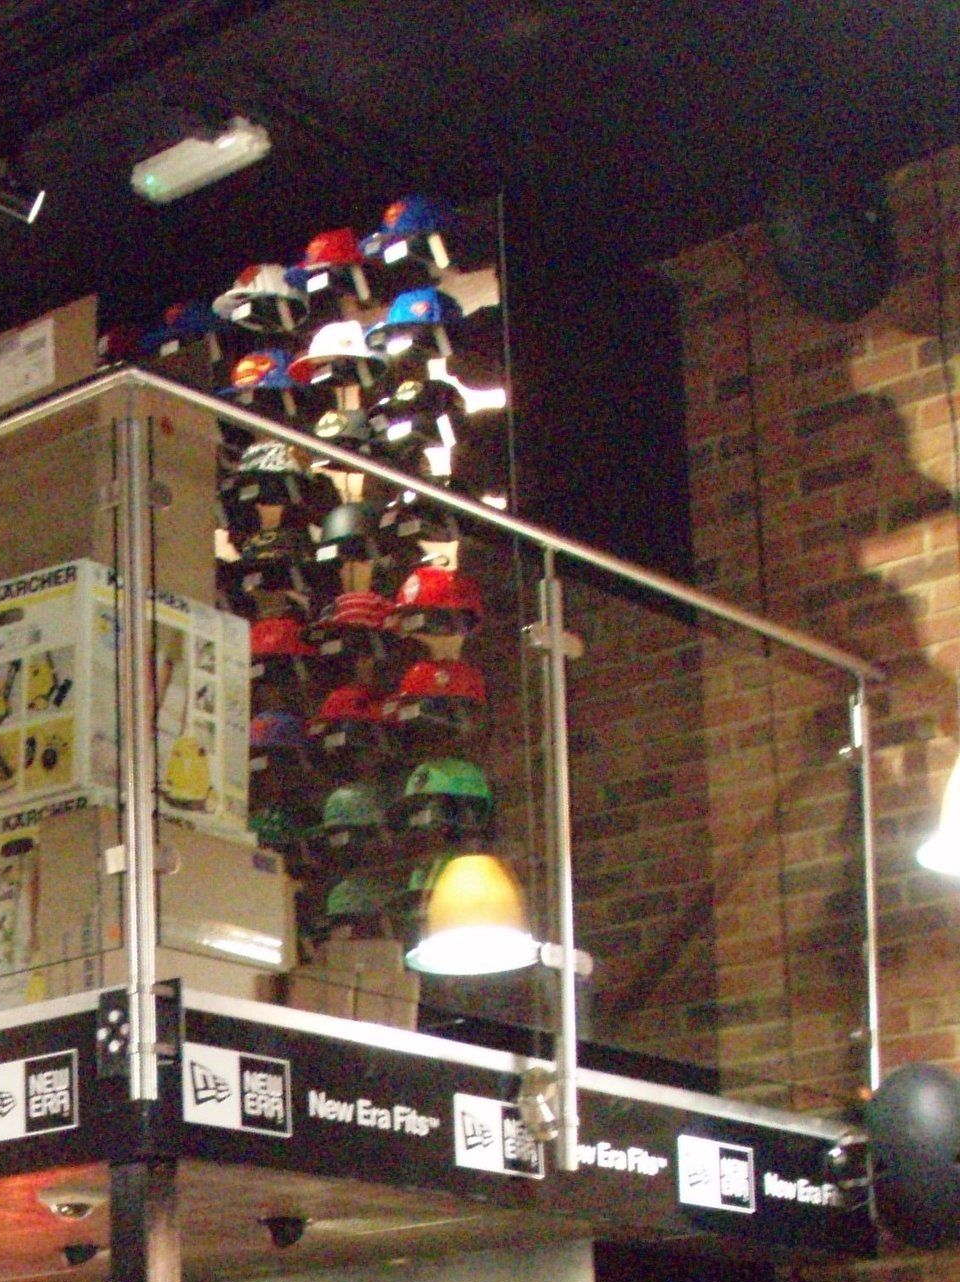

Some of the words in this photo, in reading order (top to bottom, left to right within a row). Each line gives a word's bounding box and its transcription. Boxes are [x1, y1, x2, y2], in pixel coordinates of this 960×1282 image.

[29, 1067, 70, 1097] NEW
[243, 1070, 284, 1095] NEW
[29, 1091, 70, 1118] ERA
[244, 1094, 284, 1122] ERA
[309, 1089, 355, 1123] New
[356, 1099, 391, 1129] Era
